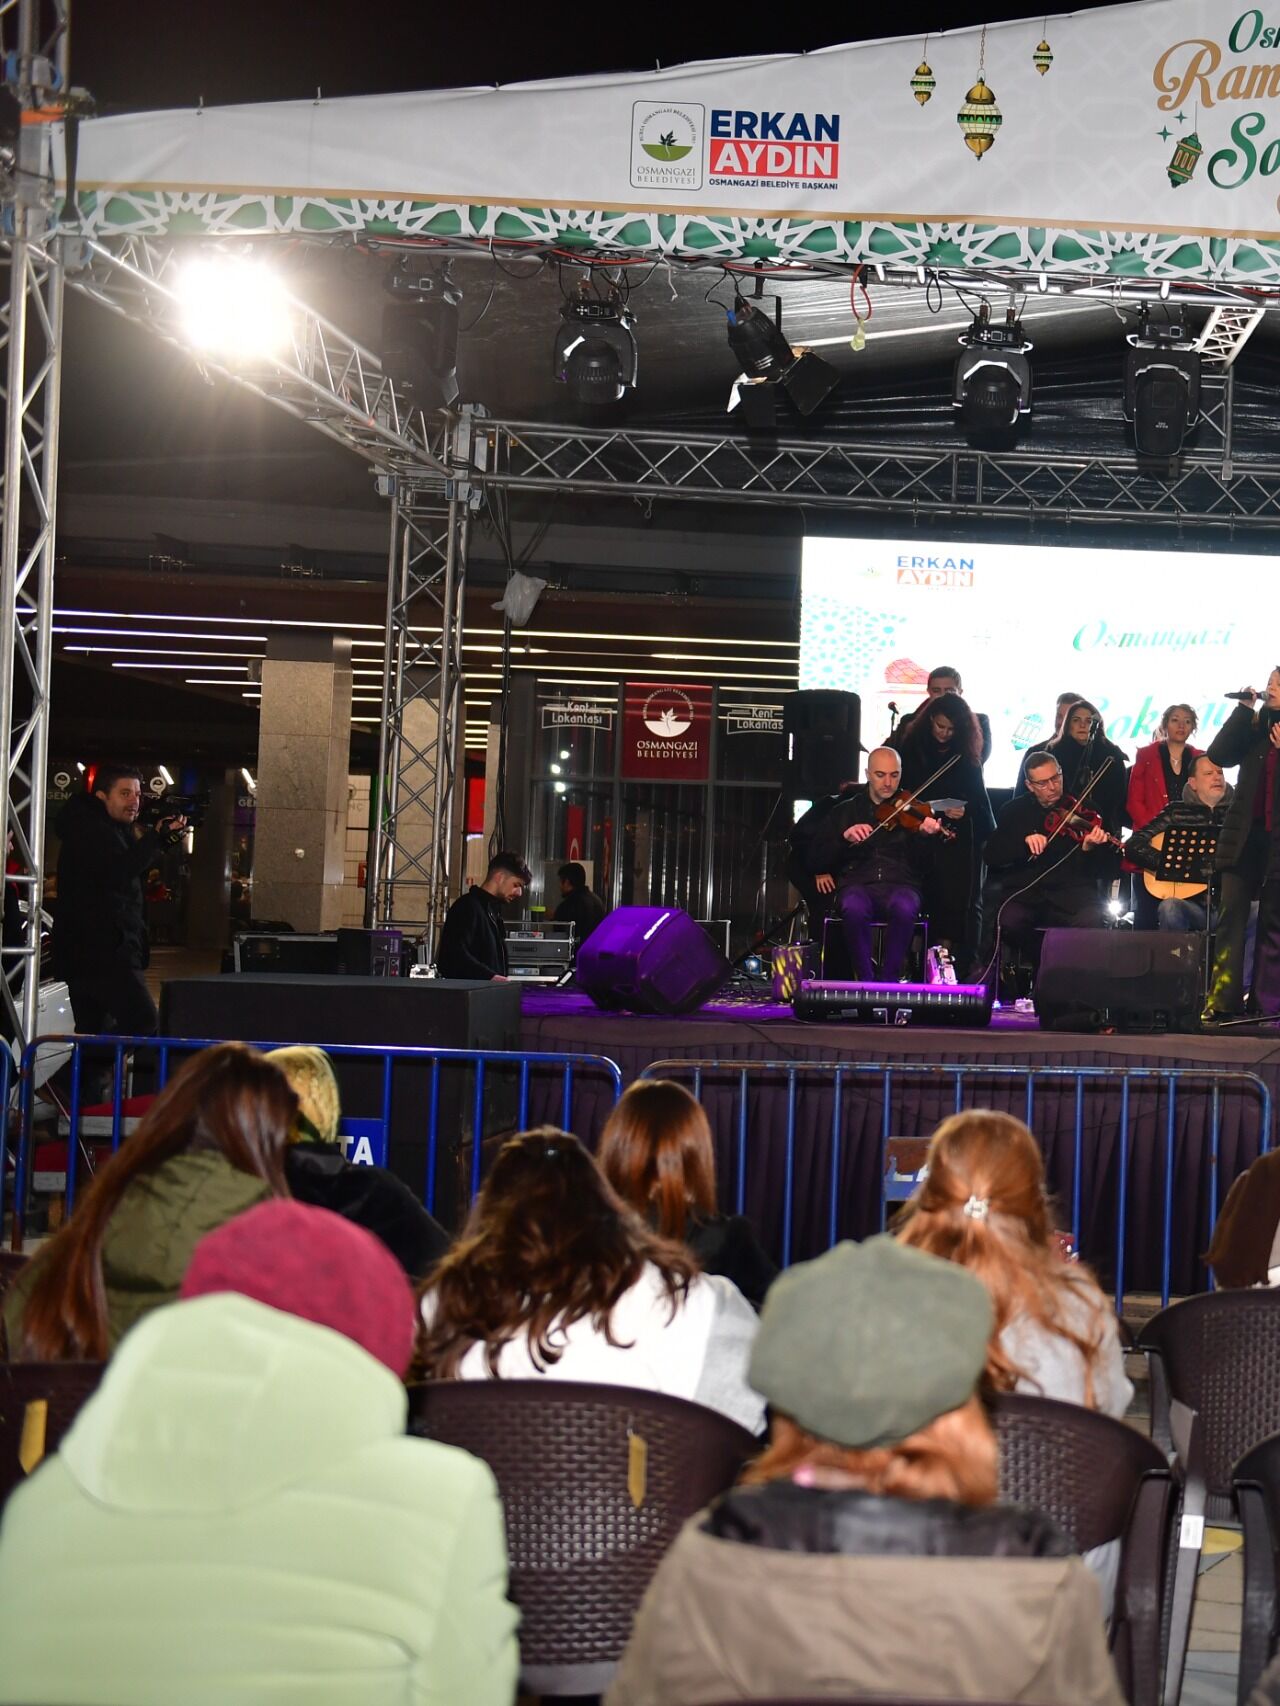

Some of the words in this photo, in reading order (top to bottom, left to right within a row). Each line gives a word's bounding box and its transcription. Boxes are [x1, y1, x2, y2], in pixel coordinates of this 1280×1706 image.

[710, 109, 840, 142] ERKAN
[713, 142, 832, 176] AYDIN
[637, 166, 695, 177] OSMANGAZİ
[637, 175, 695, 185] BELEDİYESİ
[709, 178, 759, 187] OSMANGAZİ
[760, 180, 800, 189] BELEDİYE
[801, 181, 838, 190] BAŞKANI
[897, 555, 974, 570] ERKAN
[898, 569, 972, 587] AYDIN
[567, 701, 589, 713] Kent
[751, 707, 773, 718] Kent
[551, 711, 603, 724] Lokantası
[636, 740, 698, 751] OSMANGAZİ
[637, 750, 698, 759] BELEDİYESİ
